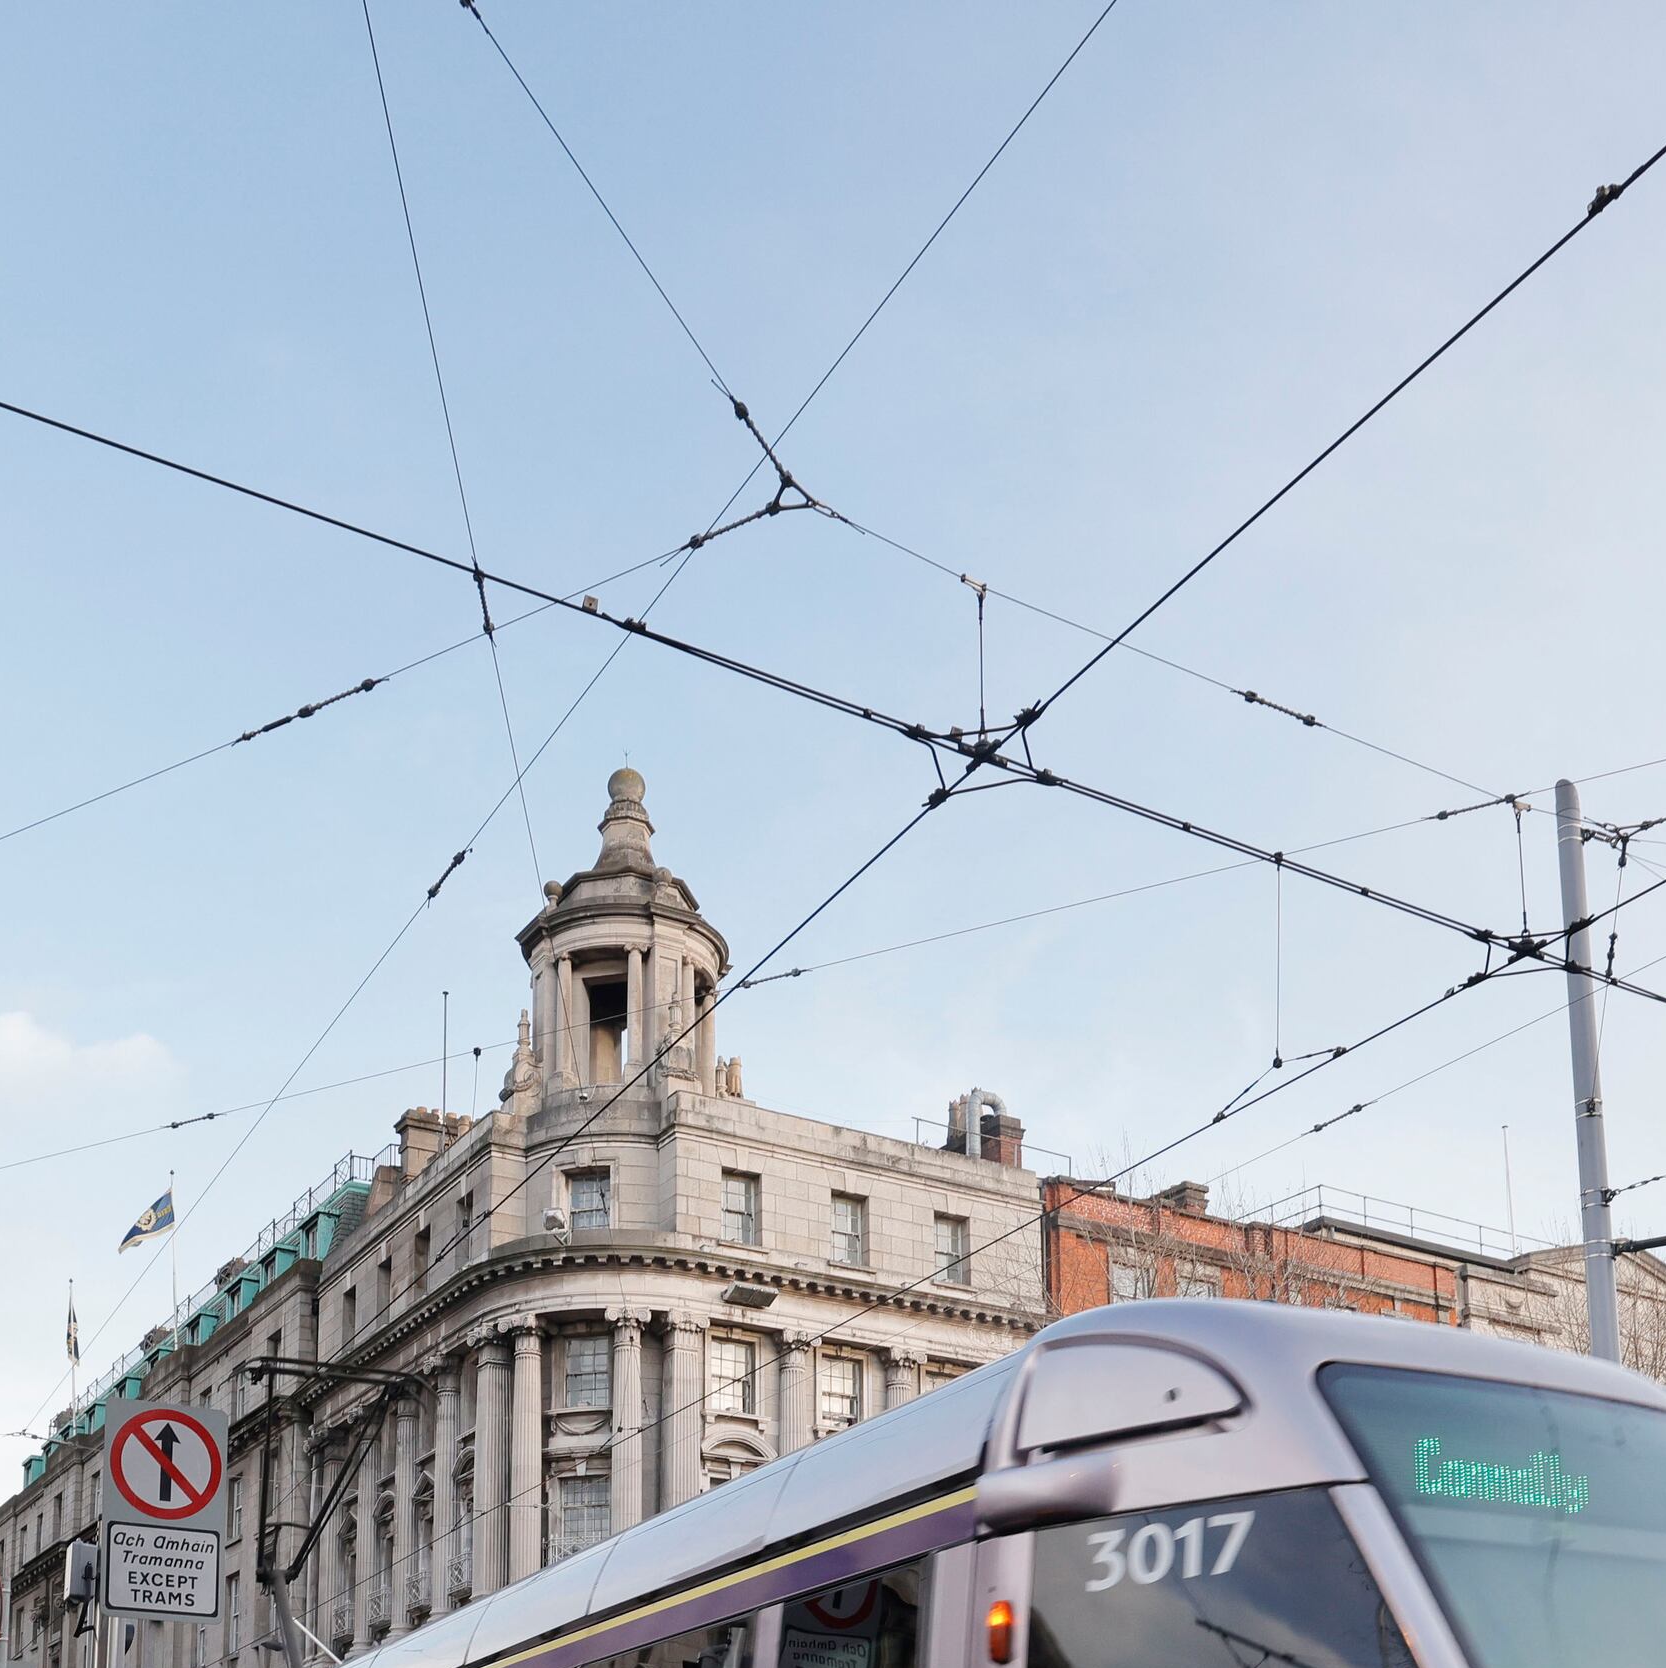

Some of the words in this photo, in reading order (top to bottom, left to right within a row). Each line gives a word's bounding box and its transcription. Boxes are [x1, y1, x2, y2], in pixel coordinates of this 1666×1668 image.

[113, 1531, 145, 1547] Ach
[122, 1550, 204, 1570] Tramanna
[1085, 1511, 1255, 1592] 3017
[128, 1571, 198, 1589] EXCEPT
[131, 1589, 195, 1607] TRAMS
